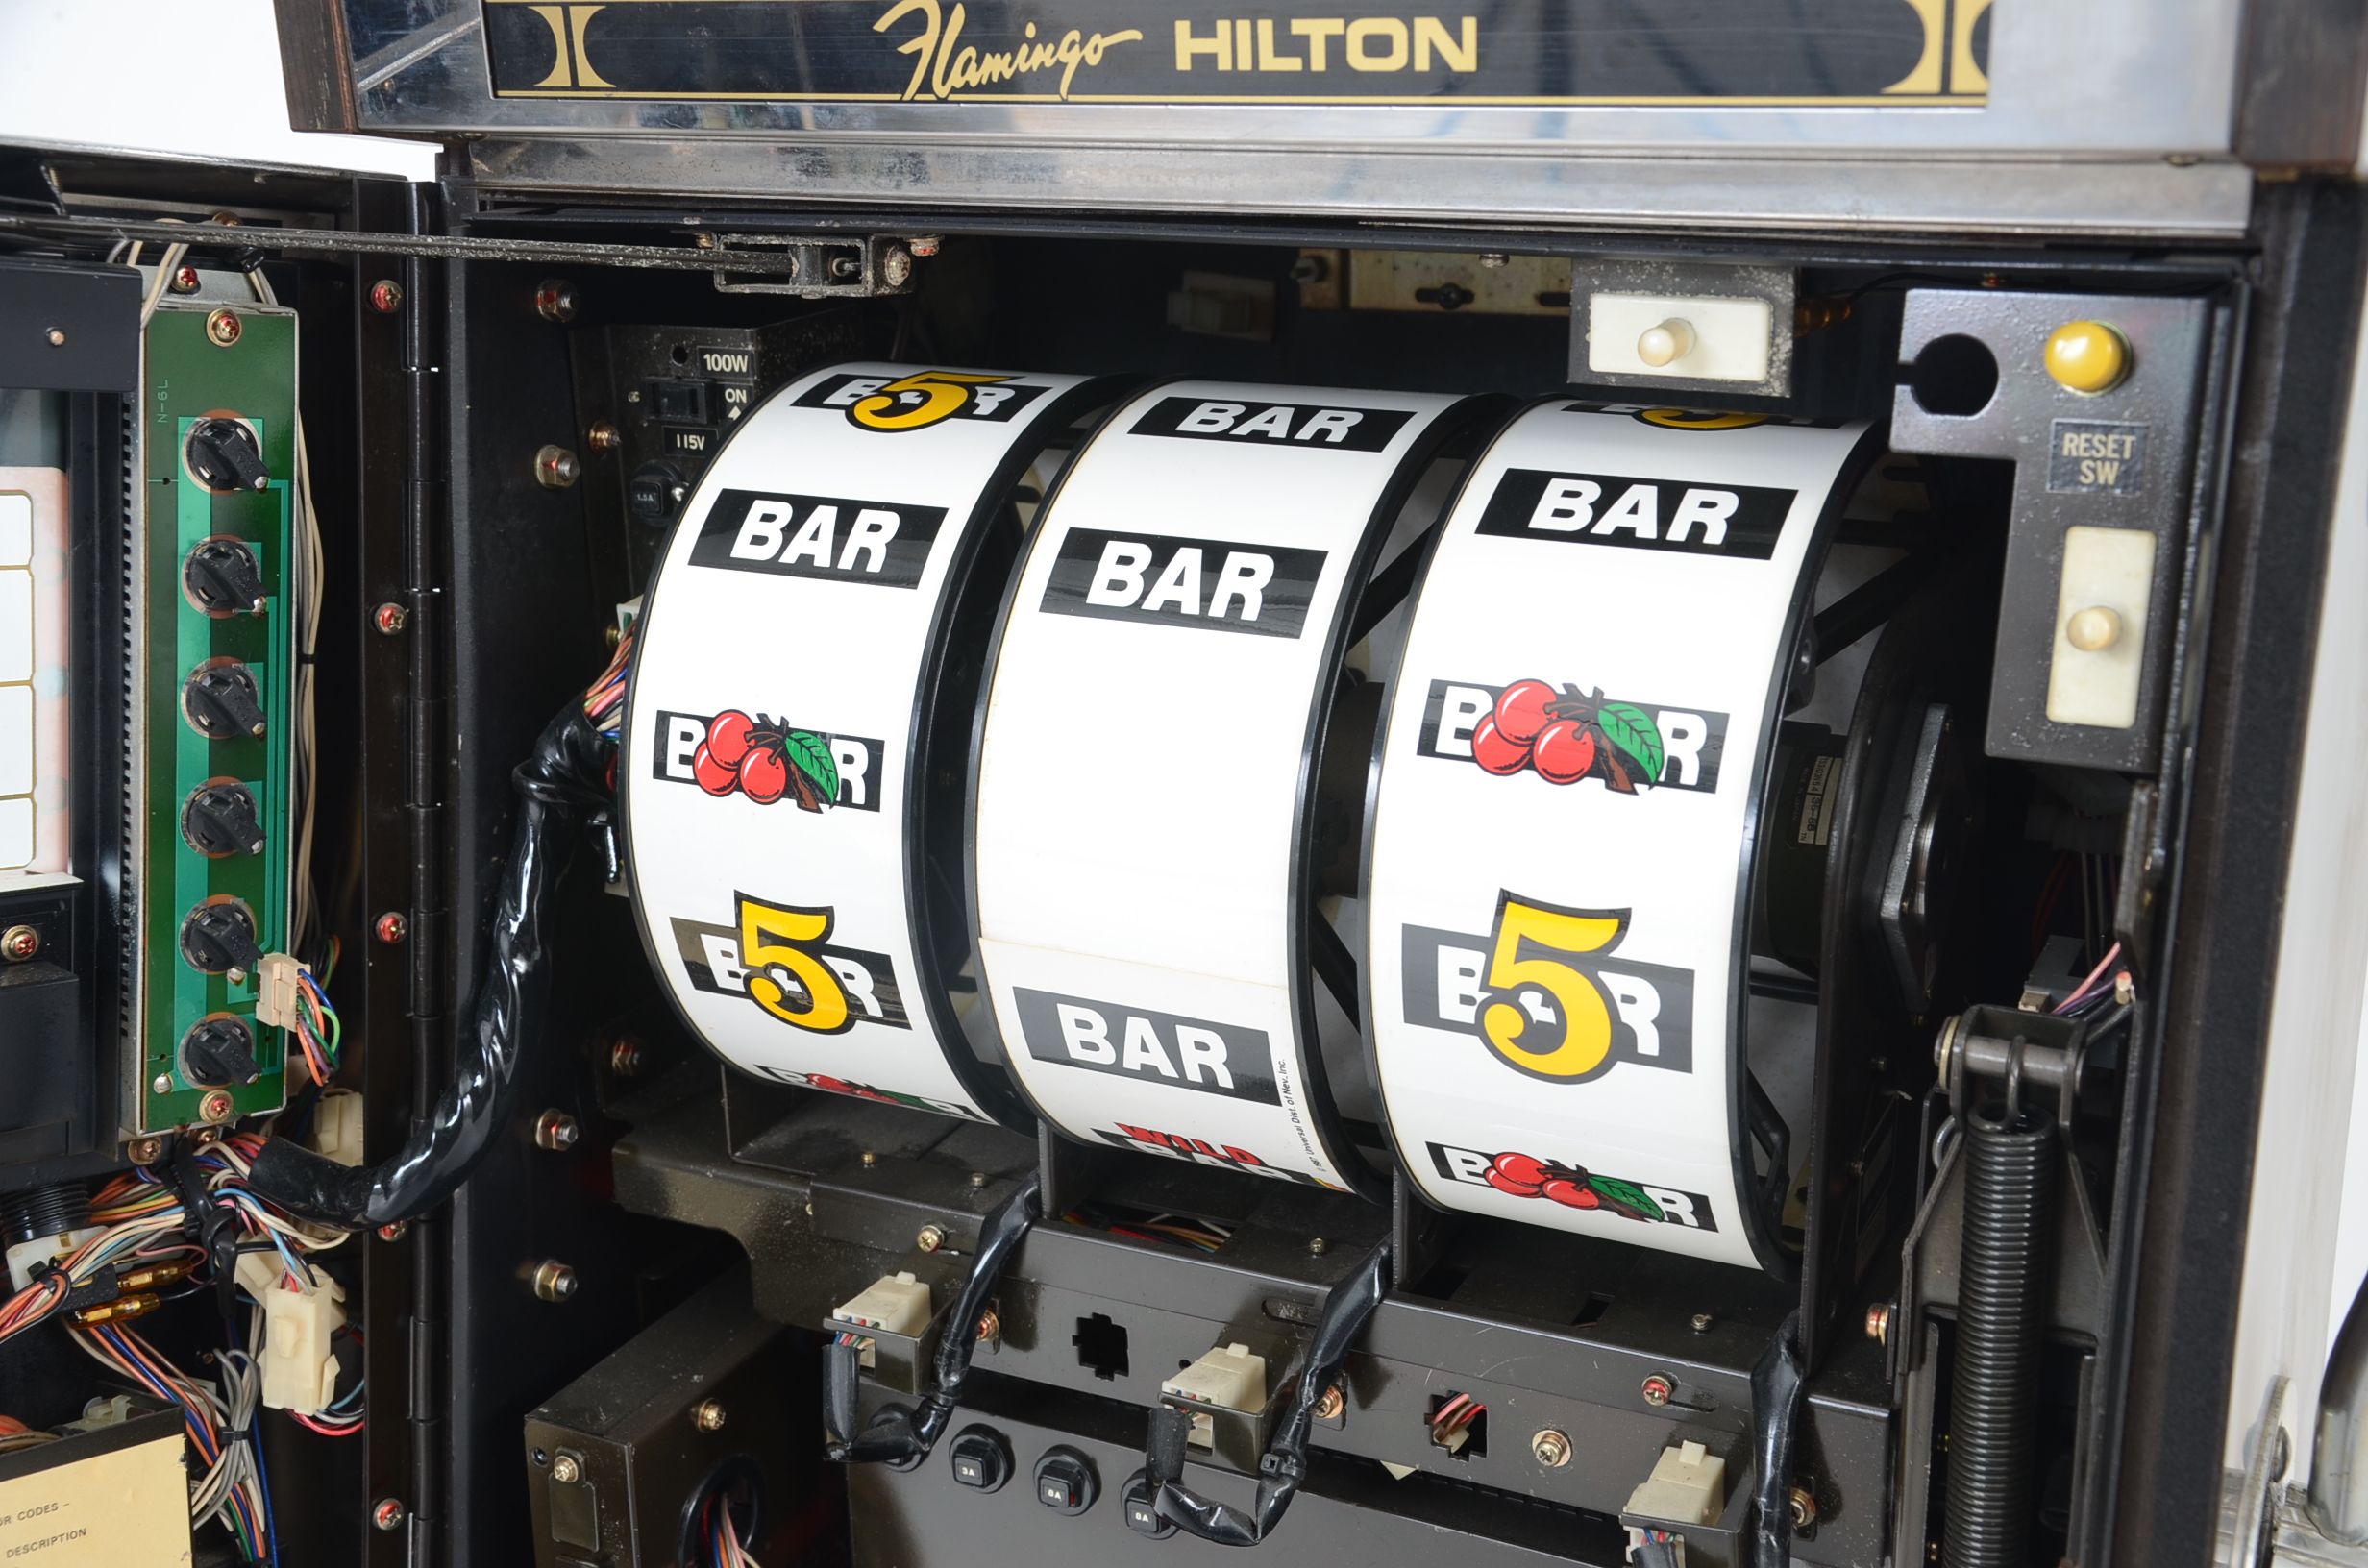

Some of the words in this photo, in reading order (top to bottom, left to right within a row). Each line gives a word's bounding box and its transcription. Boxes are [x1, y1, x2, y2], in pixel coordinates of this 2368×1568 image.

[873, 0, 1143, 101] Flamingo
[1174, 17, 1477, 72] HILTON
[703, 354, 749, 373] 100W
[157, 379, 169, 423] N-6L
[725, 388, 748, 404] ON
[823, 378, 1016, 416] BR
[851, 370, 1015, 430] 5
[1175, 401, 1364, 443] BAR
[677, 433, 705, 450] 115V
[2061, 432, 2137, 459] RESET
[2078, 459, 2120, 485] SW
[729, 499, 900, 573] BAR
[1528, 478, 1739, 545] BAR
[1085, 539, 1275, 622] BAR
[666, 716, 869, 805] BR
[1435, 685, 1708, 786] BR
[700, 933, 884, 1017] BR
[741, 897, 849, 1031] 5
[1482, 900, 1621, 1077] 5
[1437, 944, 1662, 1057] BR
[1056, 1002, 1235, 1090] BAR
[1278, 1059, 1288, 1075] Inc.
[1284, 1095, 1295, 1106] of
[1113, 1122, 1264, 1166] WILD
[1442, 1147, 1699, 1228] BR
[17, 1502, 59, 1522] CODES
[6, 1527, 87, 1559] DESCRIPTION
